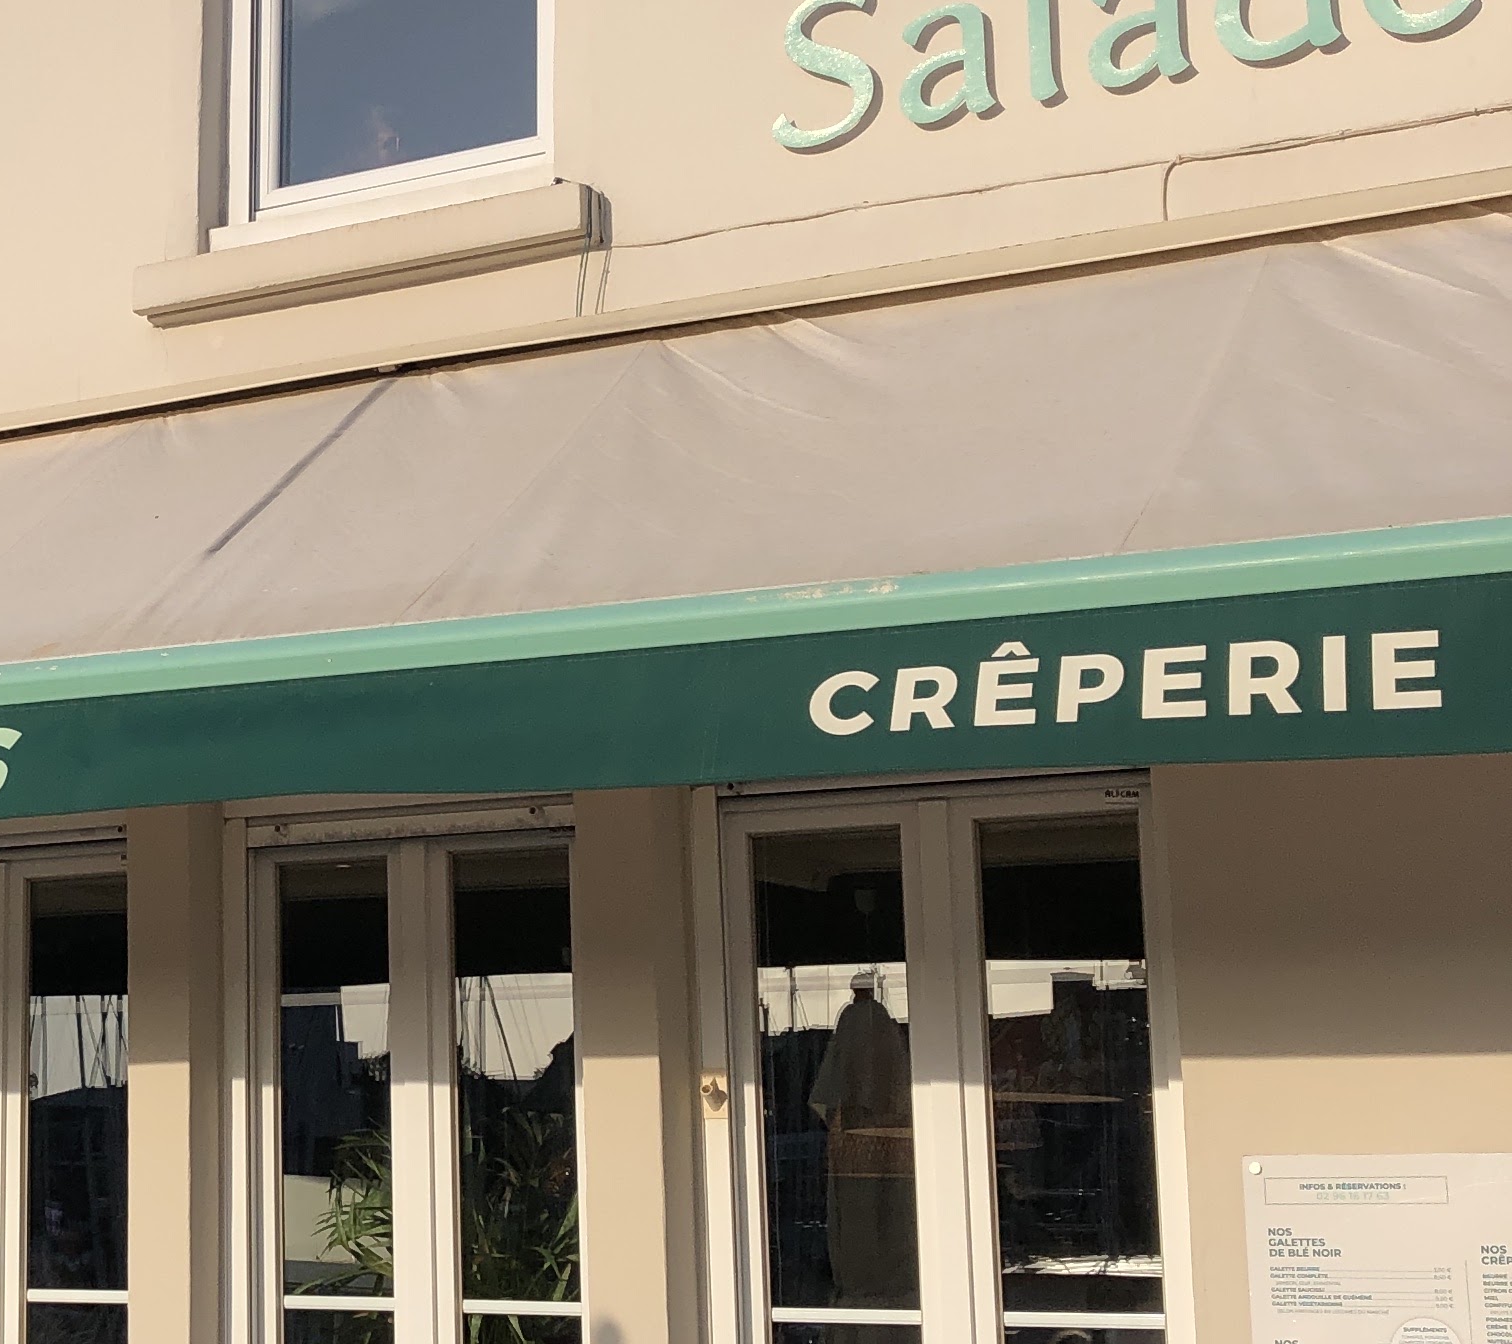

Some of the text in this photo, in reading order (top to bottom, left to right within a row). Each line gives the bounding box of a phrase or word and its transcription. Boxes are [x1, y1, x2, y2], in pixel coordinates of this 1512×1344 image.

[809, 630, 1443, 736] CRÊPERIE
[1268, 1228, 1293, 1237] NOS
[1268, 1238, 1326, 1248] GALETTES
[1269, 1247, 1342, 1258] DE BLÉ NOIR
[1480, 1245, 1507, 1254] NOS
